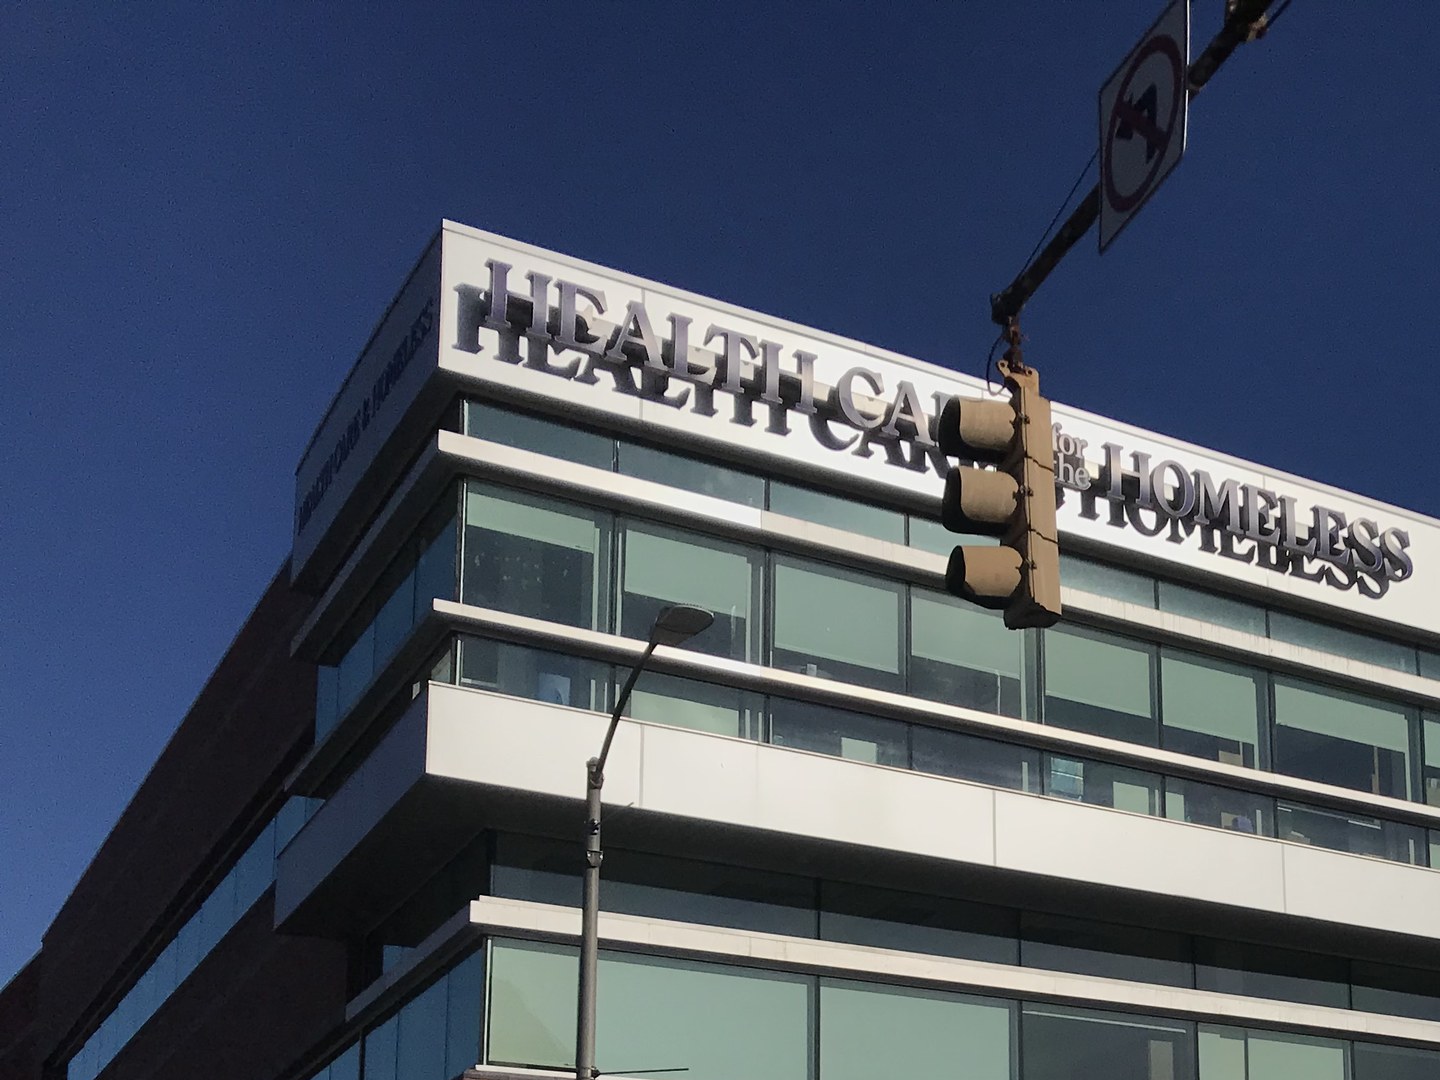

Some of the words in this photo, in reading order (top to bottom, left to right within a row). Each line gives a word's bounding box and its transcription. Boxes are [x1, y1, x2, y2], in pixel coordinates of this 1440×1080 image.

[483, 257, 818, 415] HEALTH
[1053, 452, 1092, 490] he
[1101, 443, 1414, 583] HOMELESS
